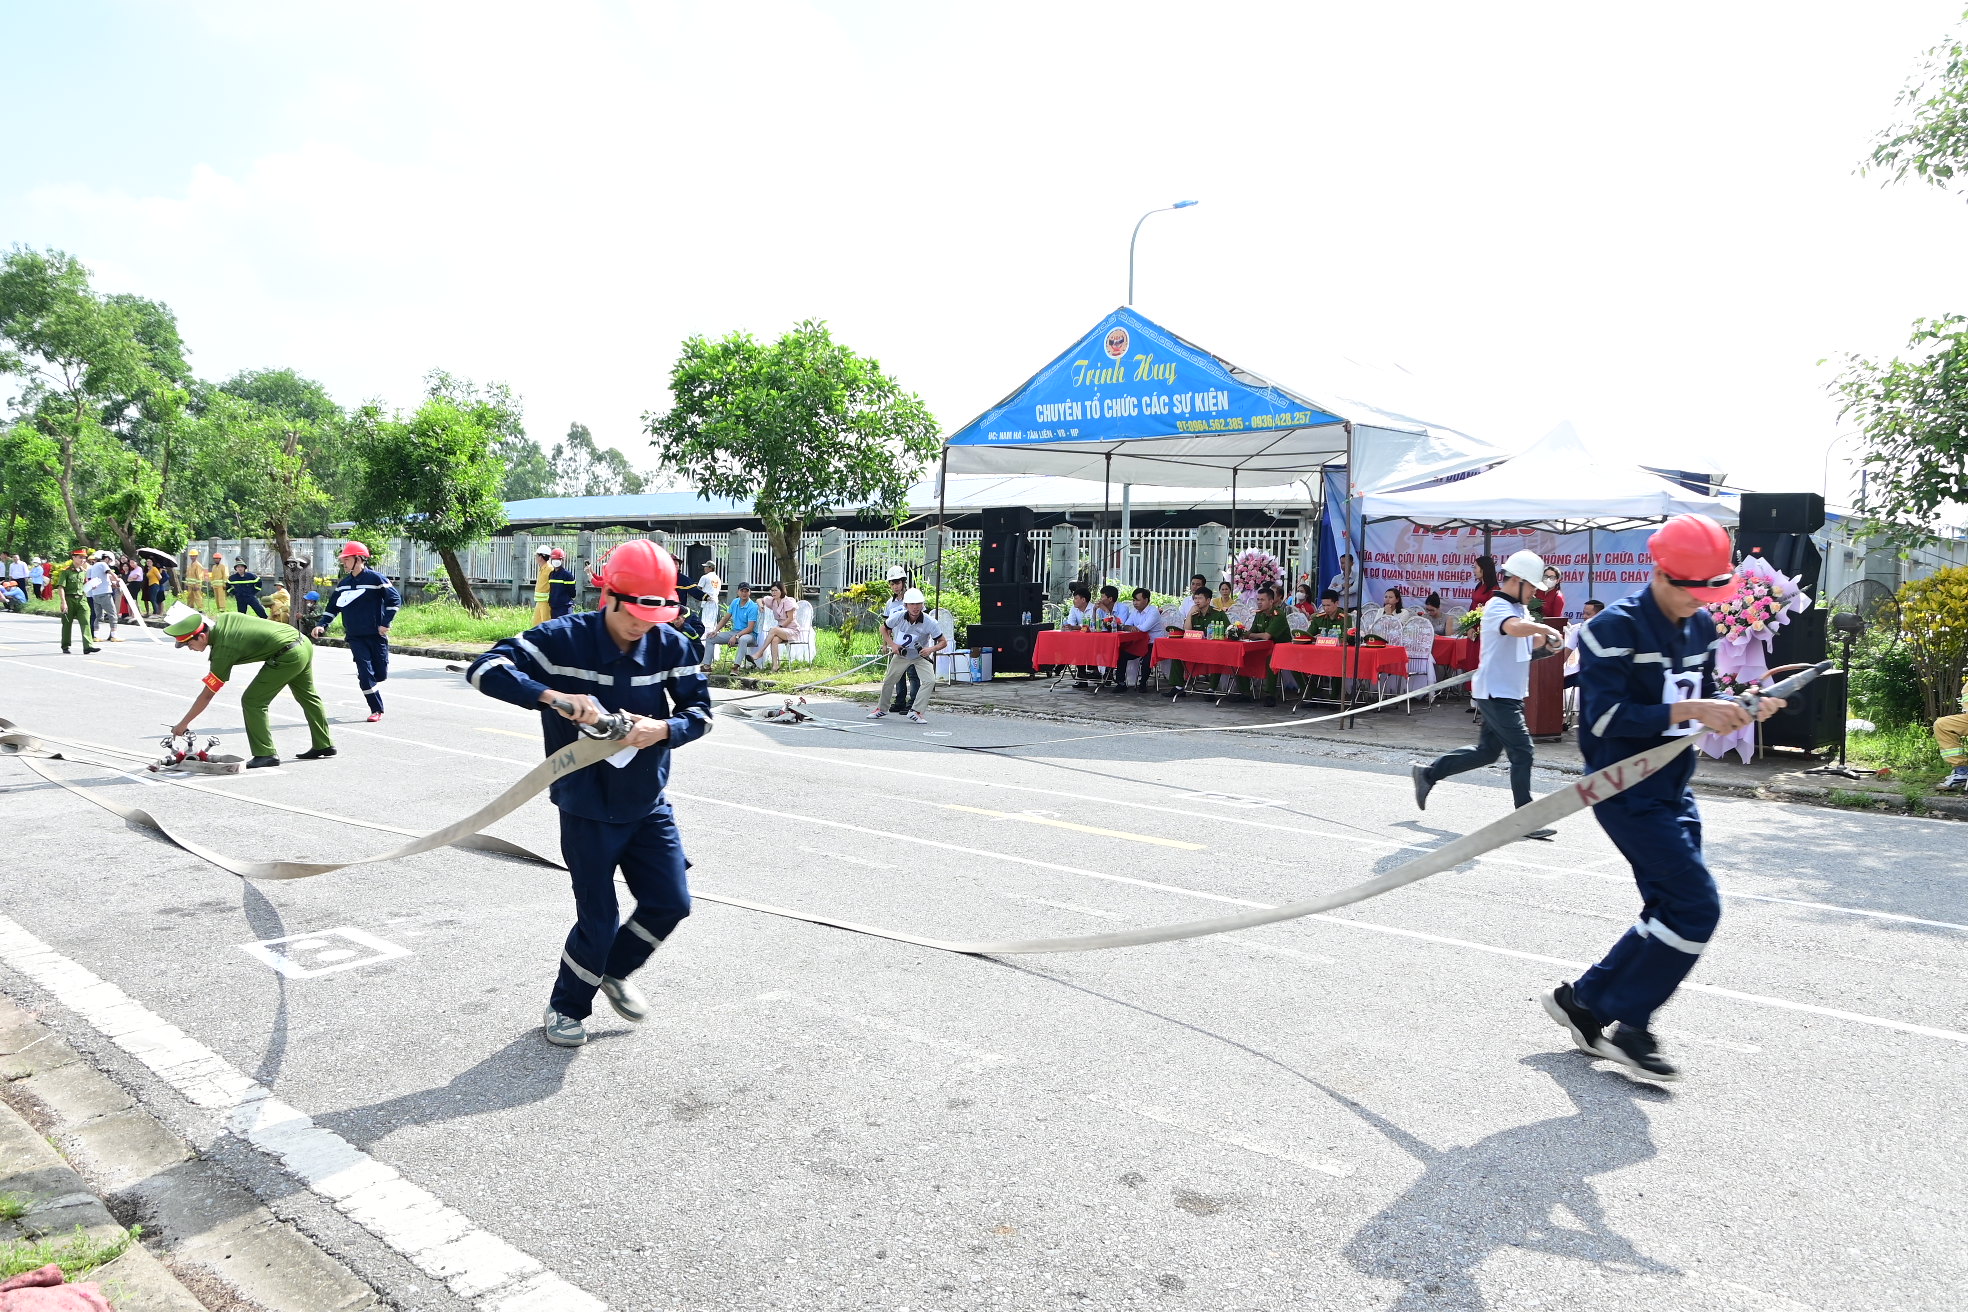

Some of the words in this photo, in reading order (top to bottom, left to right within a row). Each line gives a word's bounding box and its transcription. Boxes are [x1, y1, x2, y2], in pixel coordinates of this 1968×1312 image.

[1071, 357, 1125, 391] Trịnh
[1133, 353, 1177, 385] Huy
[1035, 398, 1082, 422] CHUYÊN
[1085, 393, 1101, 419] TỔ
[1104, 394, 1138, 418] CHỨC
[1142, 392, 1169, 415] CÁC
[1173, 391, 1192, 417] SỰ
[1195, 388, 1229, 415] KIỆN
[1605, 550, 1634, 564] CHỮA
[1405, 569, 1435, 580] DOANH
[1437, 569, 1472, 584] NGHIỆP
[1621, 568, 1650, 582] CHÁY
